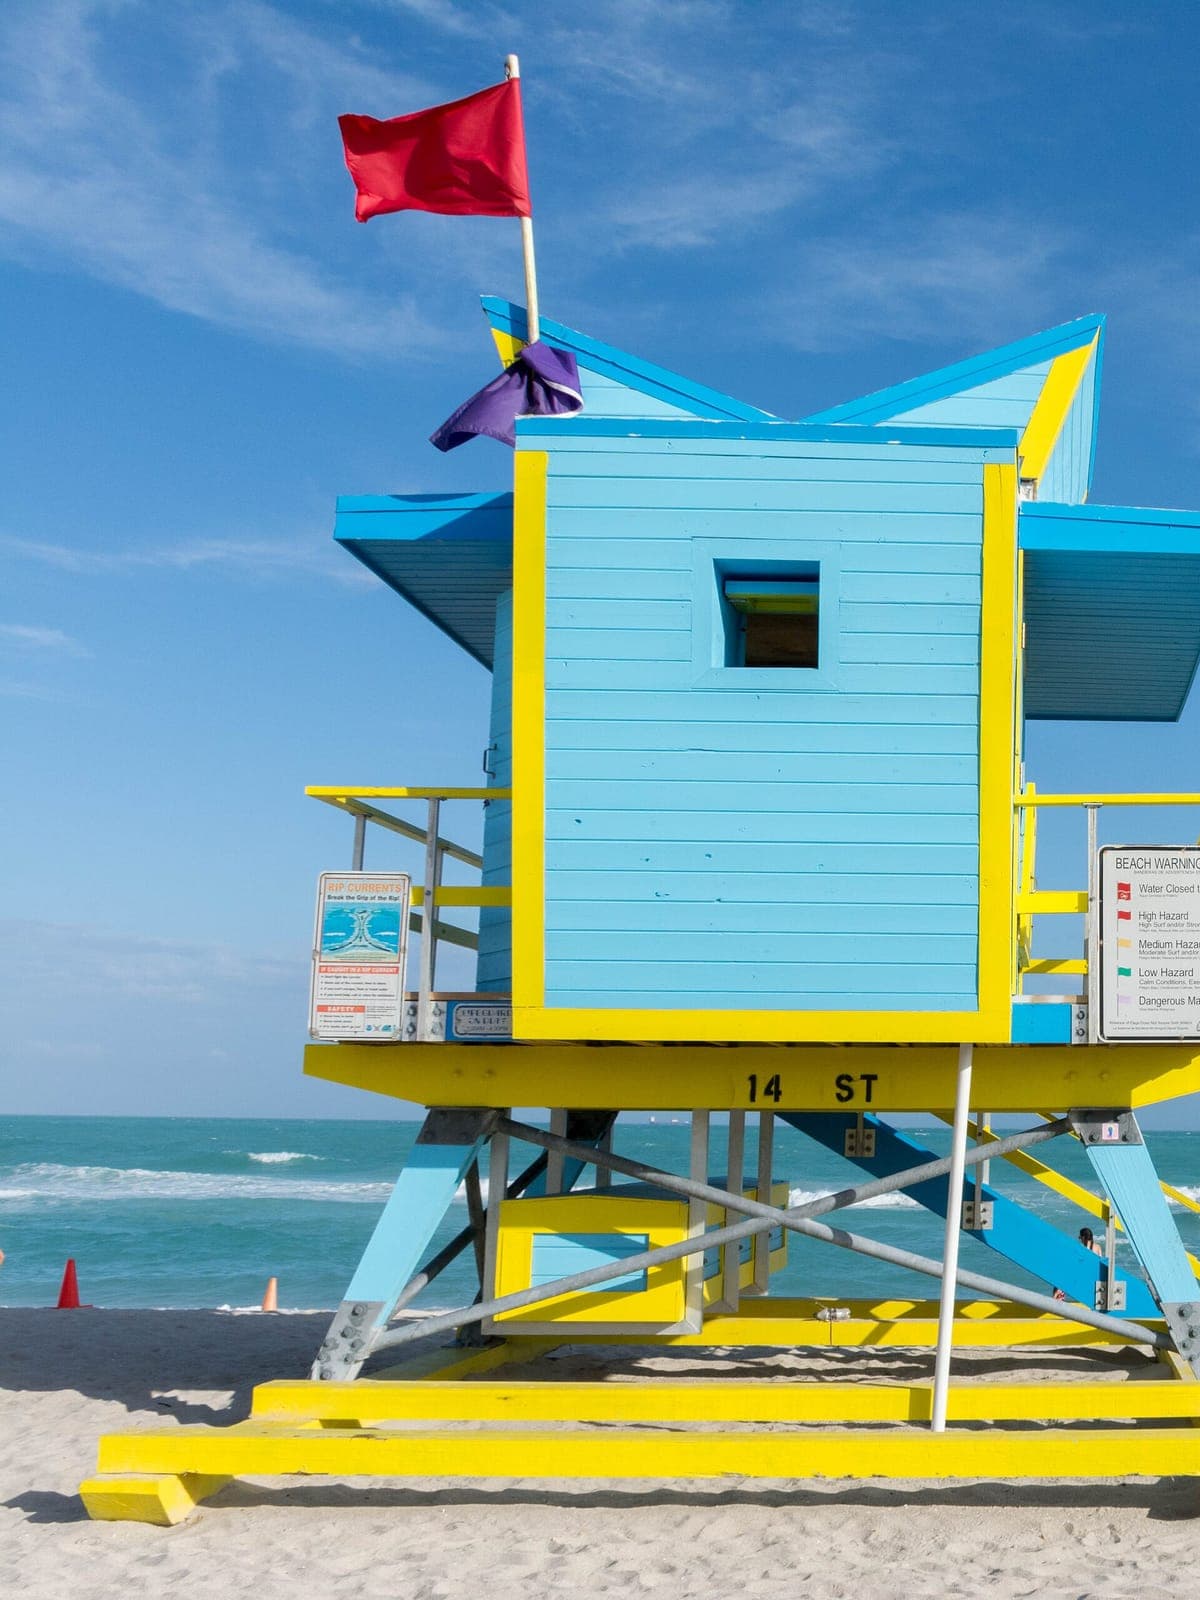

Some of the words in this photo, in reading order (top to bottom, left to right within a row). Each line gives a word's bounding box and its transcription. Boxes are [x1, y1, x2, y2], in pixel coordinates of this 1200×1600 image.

[1115, 858, 1151, 870] BEACH
[327, 883, 344, 892] RIP
[347, 883, 402, 892] CURRENTS
[1139, 884, 1163, 894] Water
[1165, 884, 1195, 894] Closed
[1138, 912, 1156, 922] High
[1159, 912, 1189, 920] Hazard
[1138, 939, 1173, 949] Medium
[1138, 968, 1158, 977] Low
[1160, 968, 1194, 977] Hazard
[1139, 996, 1186, 1007] Dangerous
[748, 1074, 782, 1102] 14
[835, 1074, 878, 1102] ST
